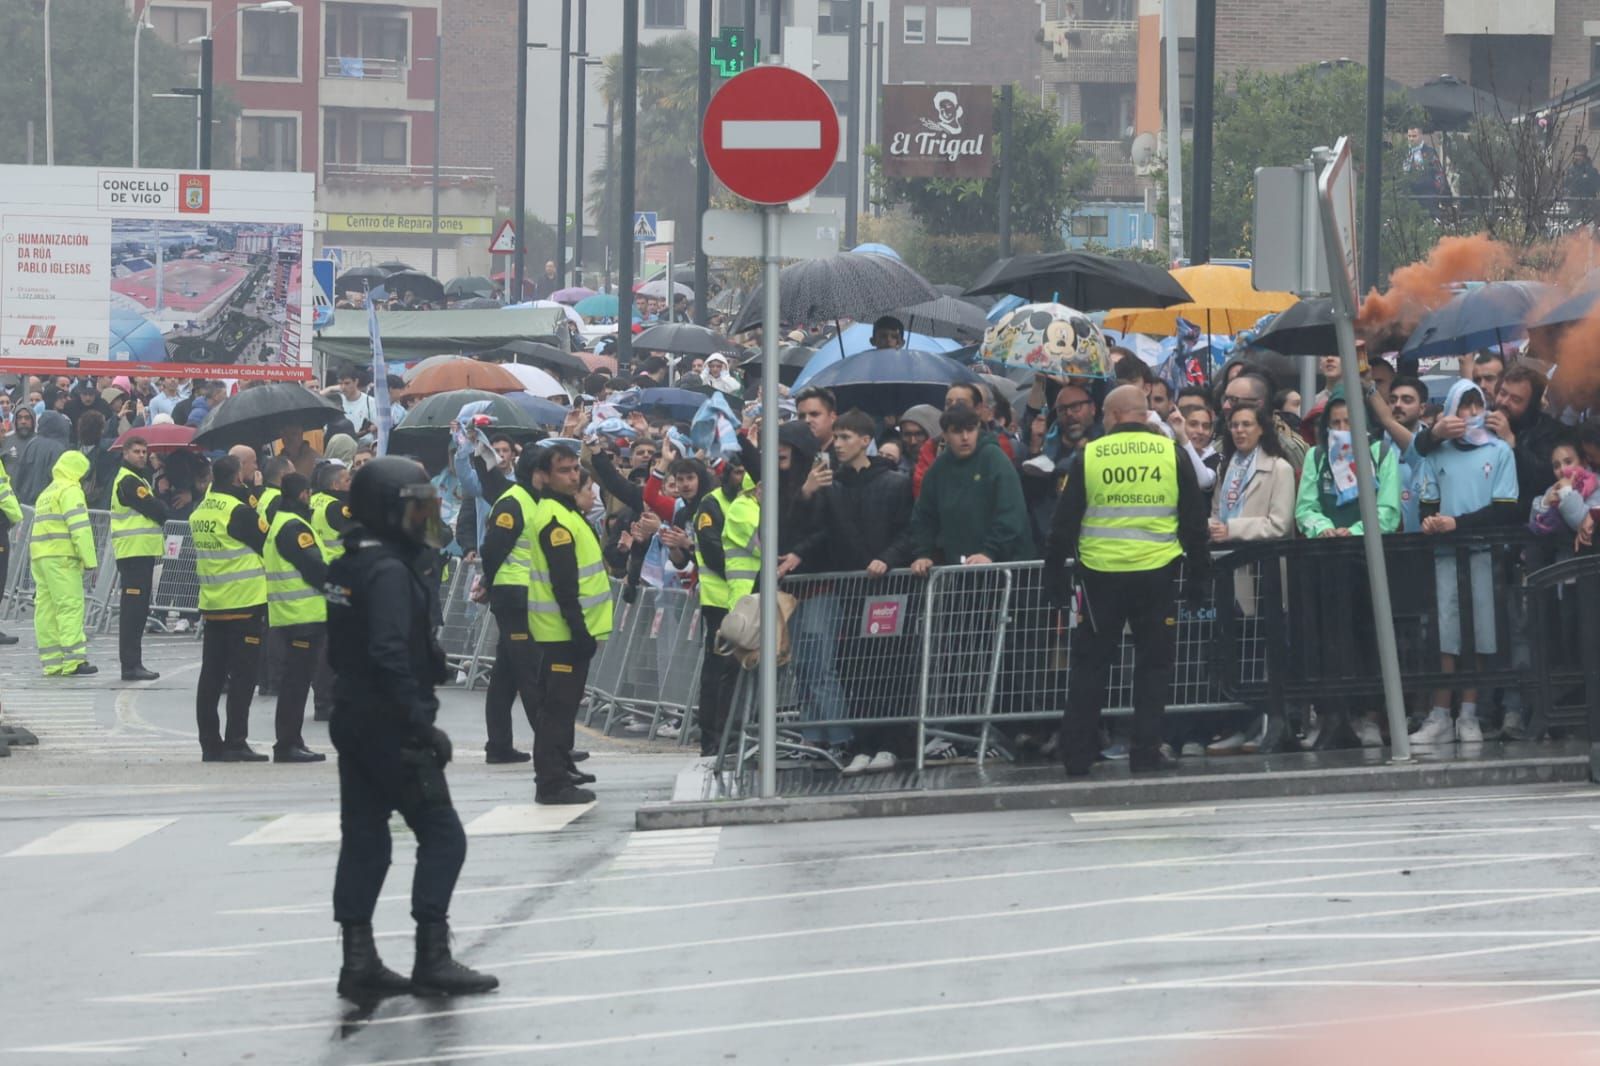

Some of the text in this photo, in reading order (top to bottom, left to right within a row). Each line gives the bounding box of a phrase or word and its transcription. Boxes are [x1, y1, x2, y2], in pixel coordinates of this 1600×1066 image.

[890, 132, 984, 161] El Trigal
[103, 180, 169, 191] CONCELLO
[111, 193, 161, 204] DE VIGO
[346, 215, 463, 231] Centro de Reparaones
[18, 232, 89, 246] HUMANIZACIÓN
[18, 247, 30, 258] DA
[18, 262, 91, 275] PABLO IGLESIAS
[1095, 442, 1165, 457] SEGURIDAD
[1102, 466, 1162, 485] 00074
[1107, 494, 1165, 504] PROSEGUR
